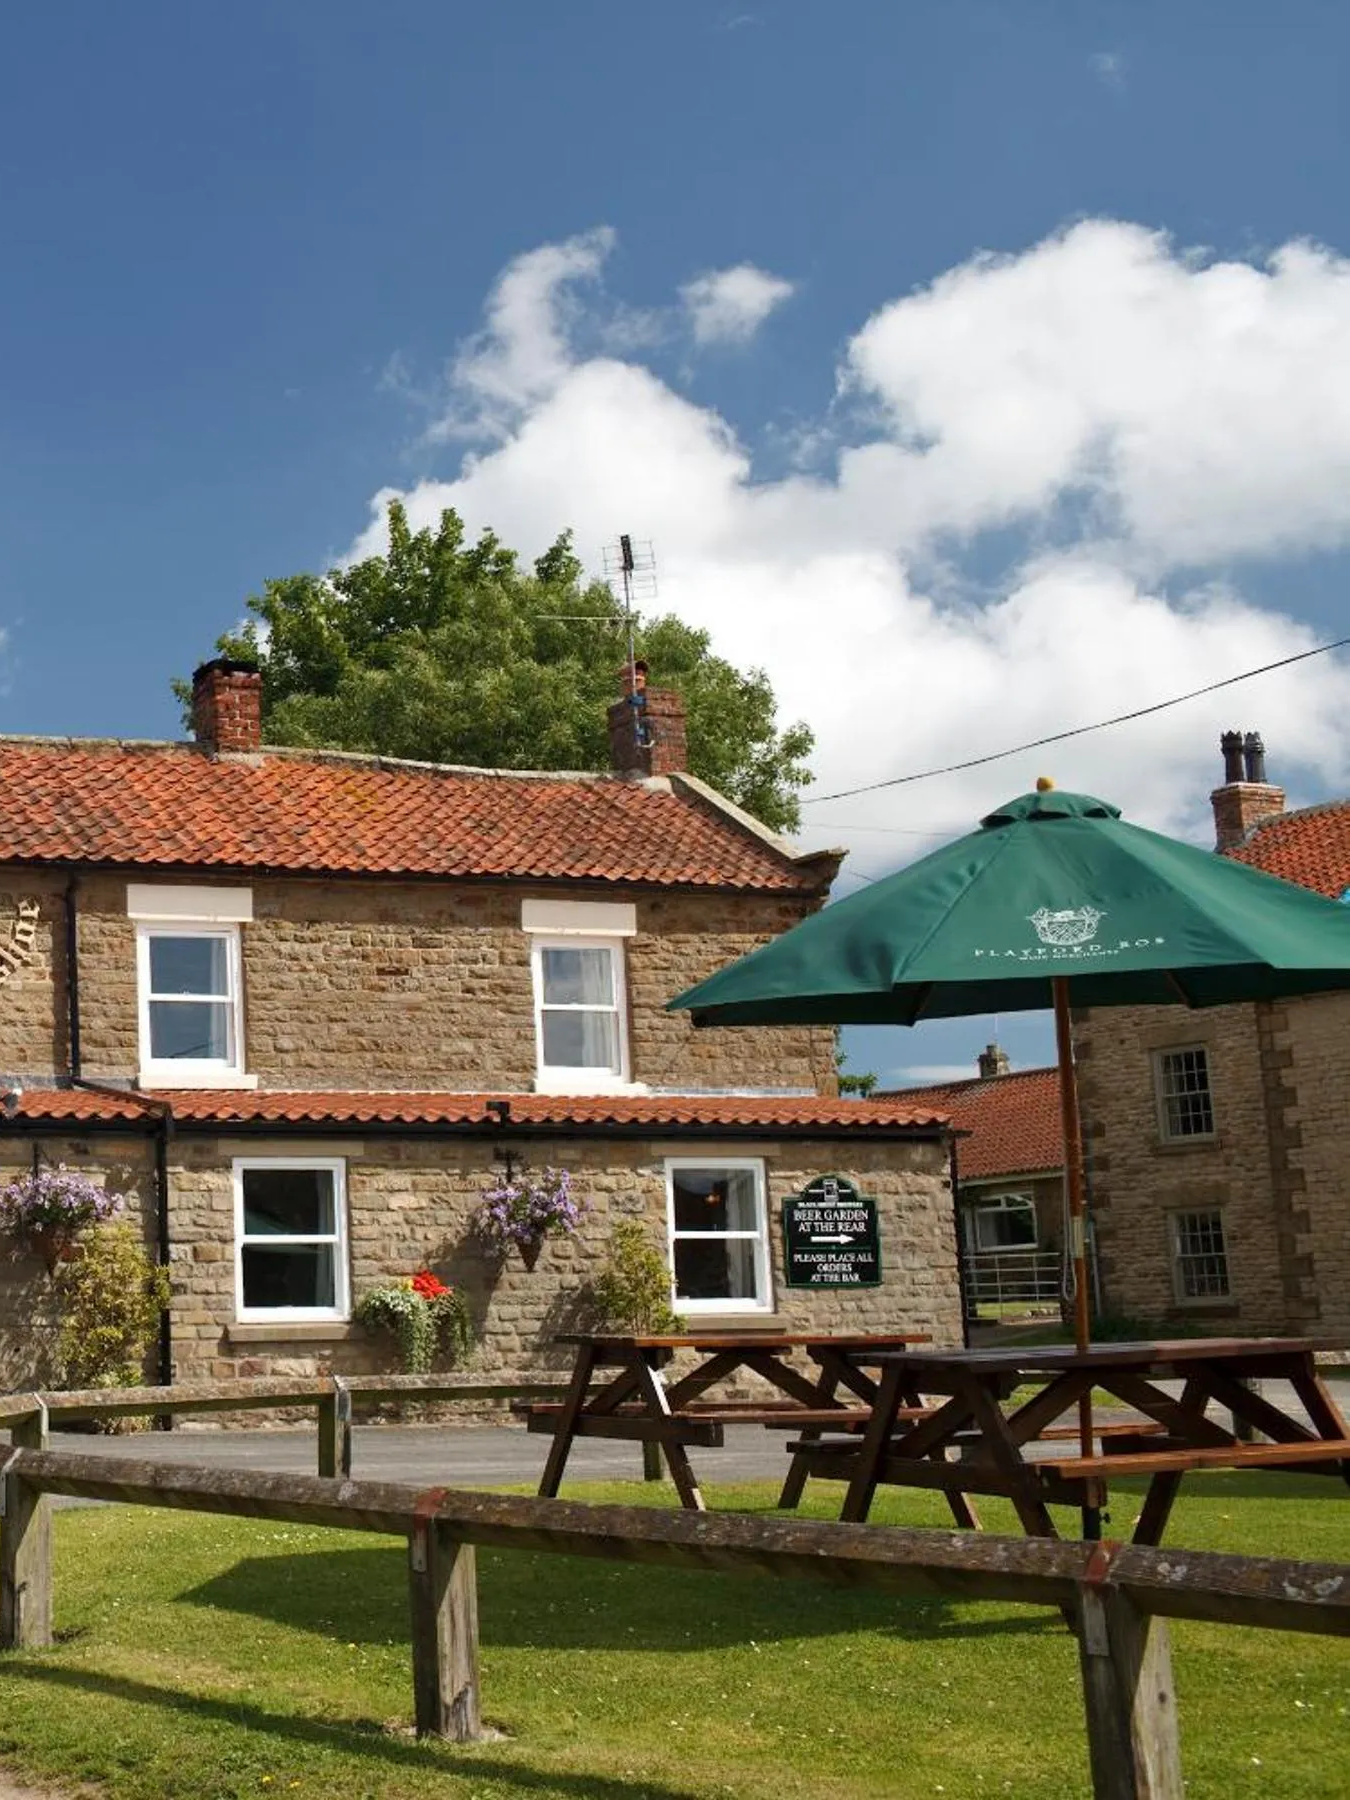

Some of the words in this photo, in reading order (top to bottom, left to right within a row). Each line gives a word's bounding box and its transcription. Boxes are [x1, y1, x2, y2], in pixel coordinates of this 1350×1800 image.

[794, 1209, 822, 1220] BEER
[824, 1209, 868, 1220] GARDEN
[799, 1222, 811, 1232] AT
[813, 1222, 835, 1232] THE
[837, 1222, 866, 1232] REAR
[794, 1253, 826, 1262] PLEASE
[828, 1253, 855, 1262] PLACE
[856, 1252, 874, 1262] ALL
[817, 1263, 852, 1272] ORDERS
[842, 1273, 861, 1282] BAR
